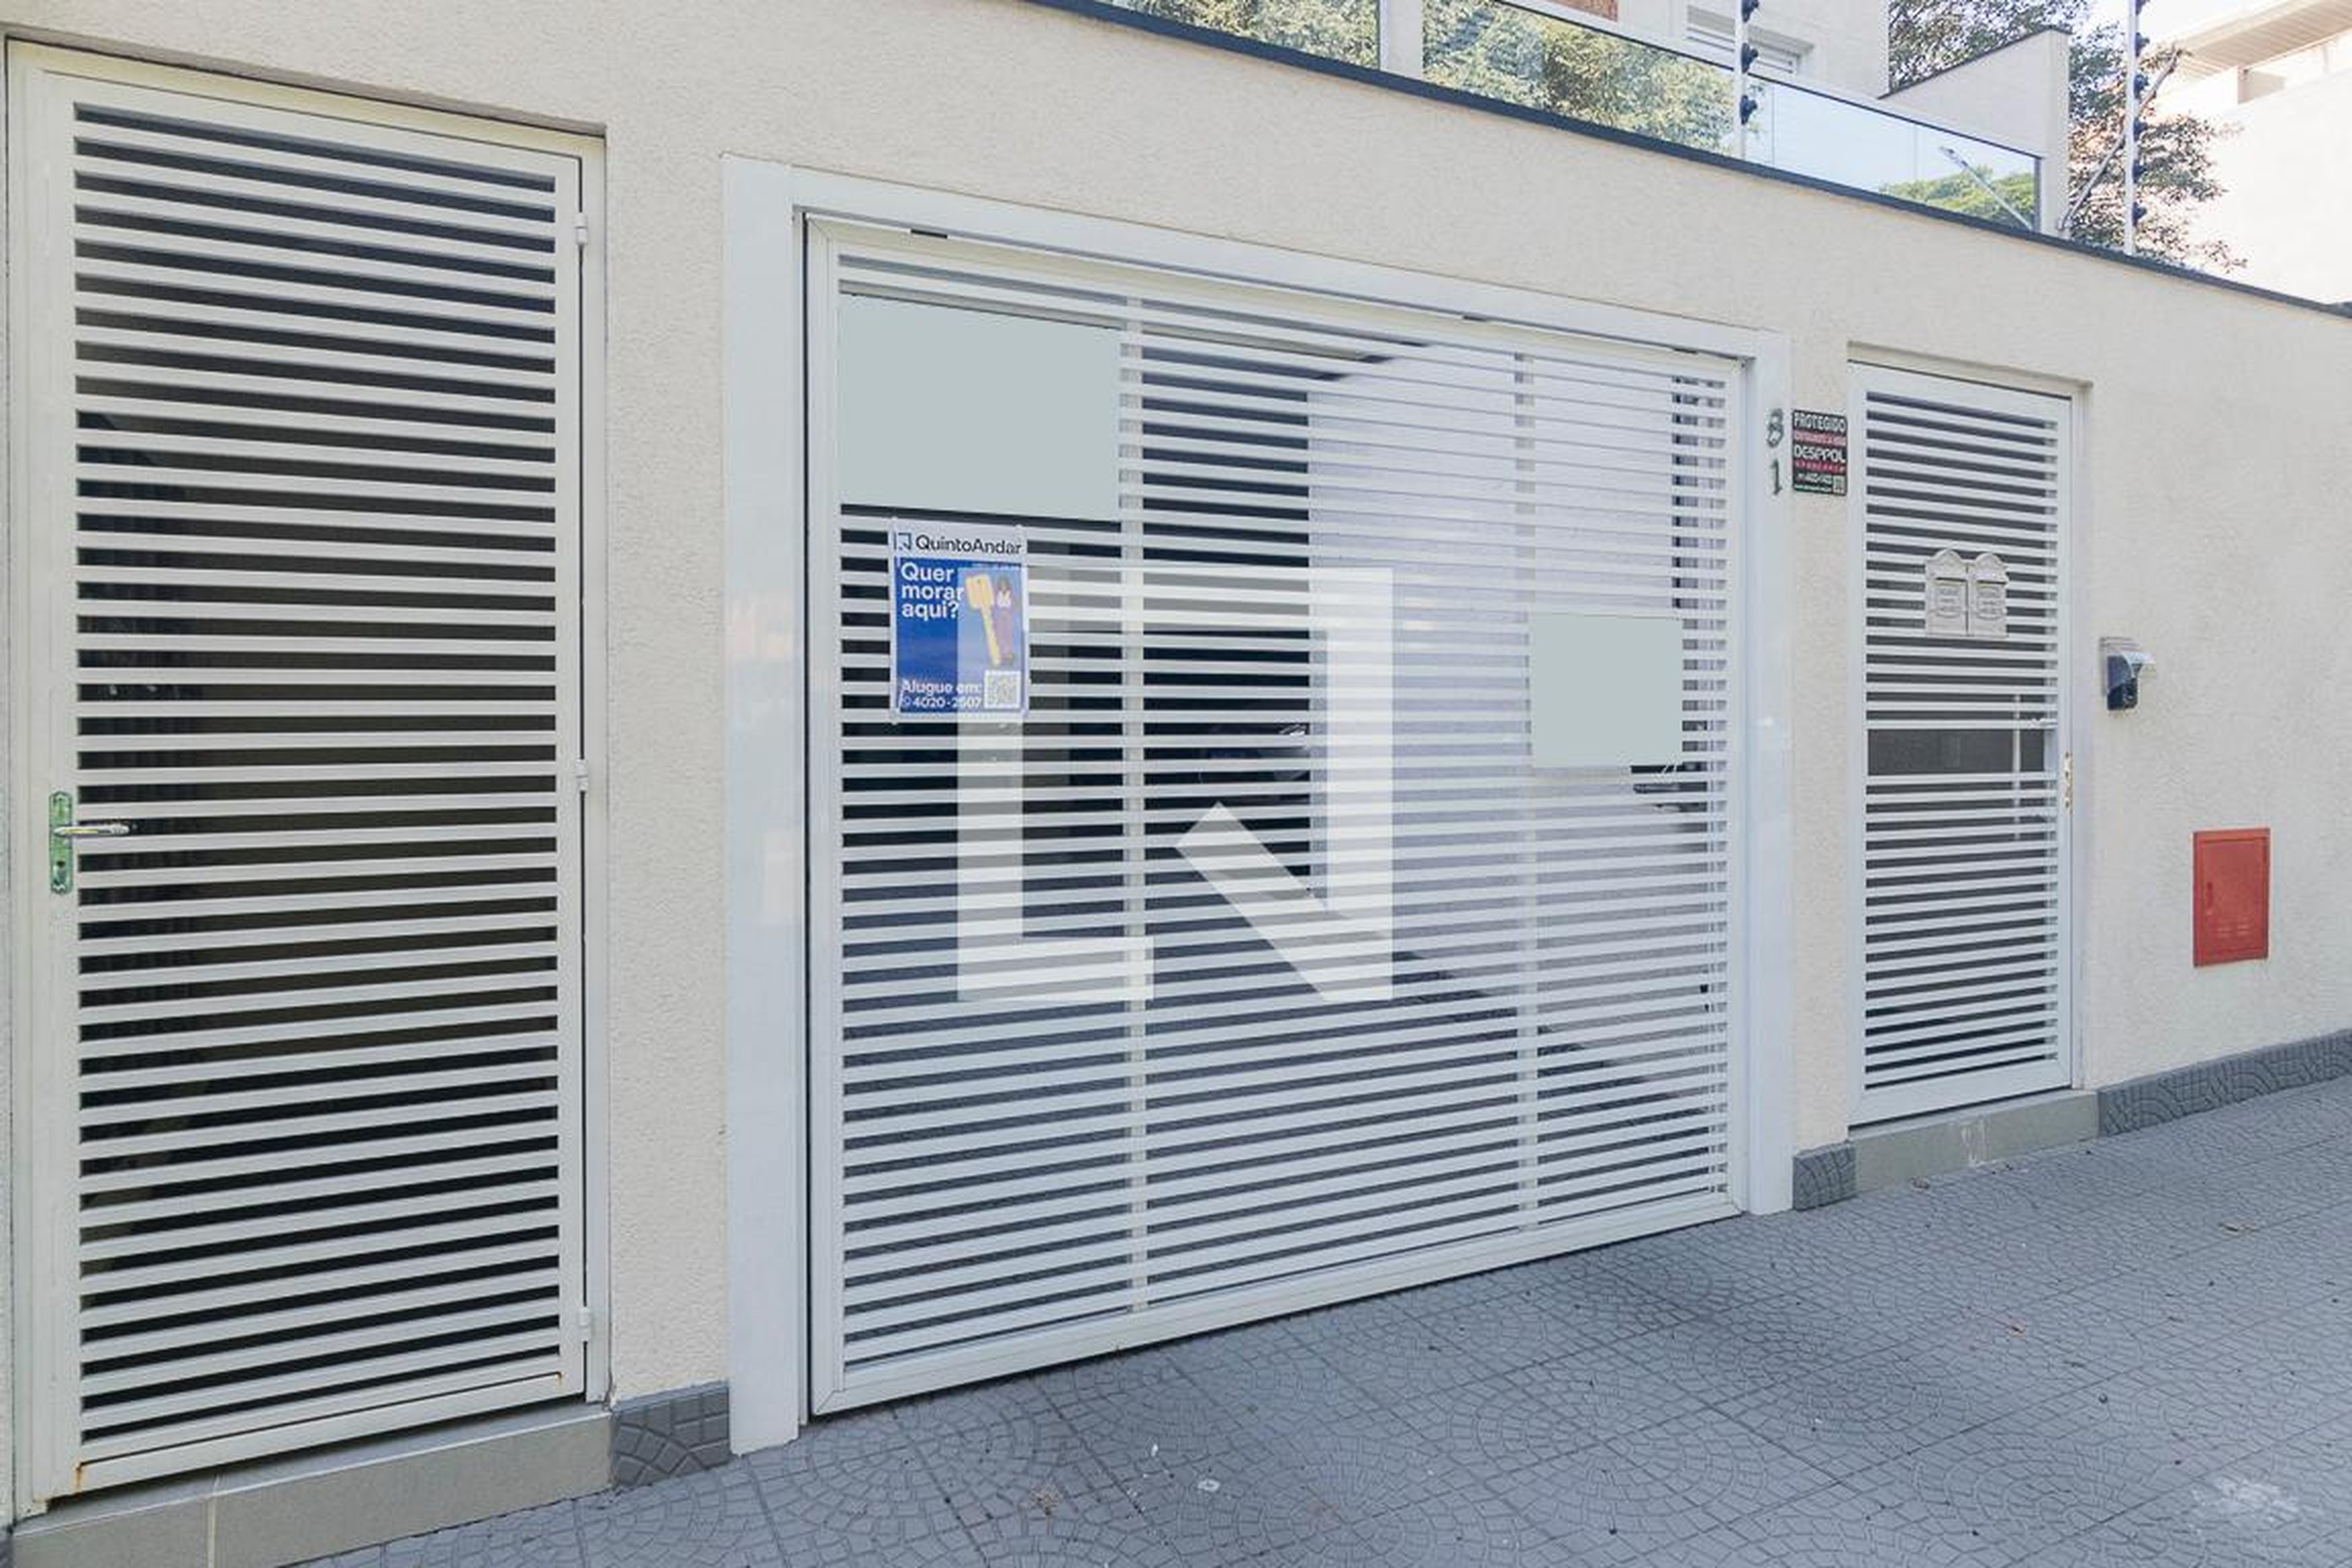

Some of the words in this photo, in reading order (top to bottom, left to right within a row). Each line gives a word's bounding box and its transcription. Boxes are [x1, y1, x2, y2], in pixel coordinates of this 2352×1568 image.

[916, 534, 1022, 554] QuintoAndar
[901, 562, 954, 582] Quer
[902, 584, 964, 601] morar
[902, 600, 959, 621] aqui?
[902, 679, 952, 696] Alugue
